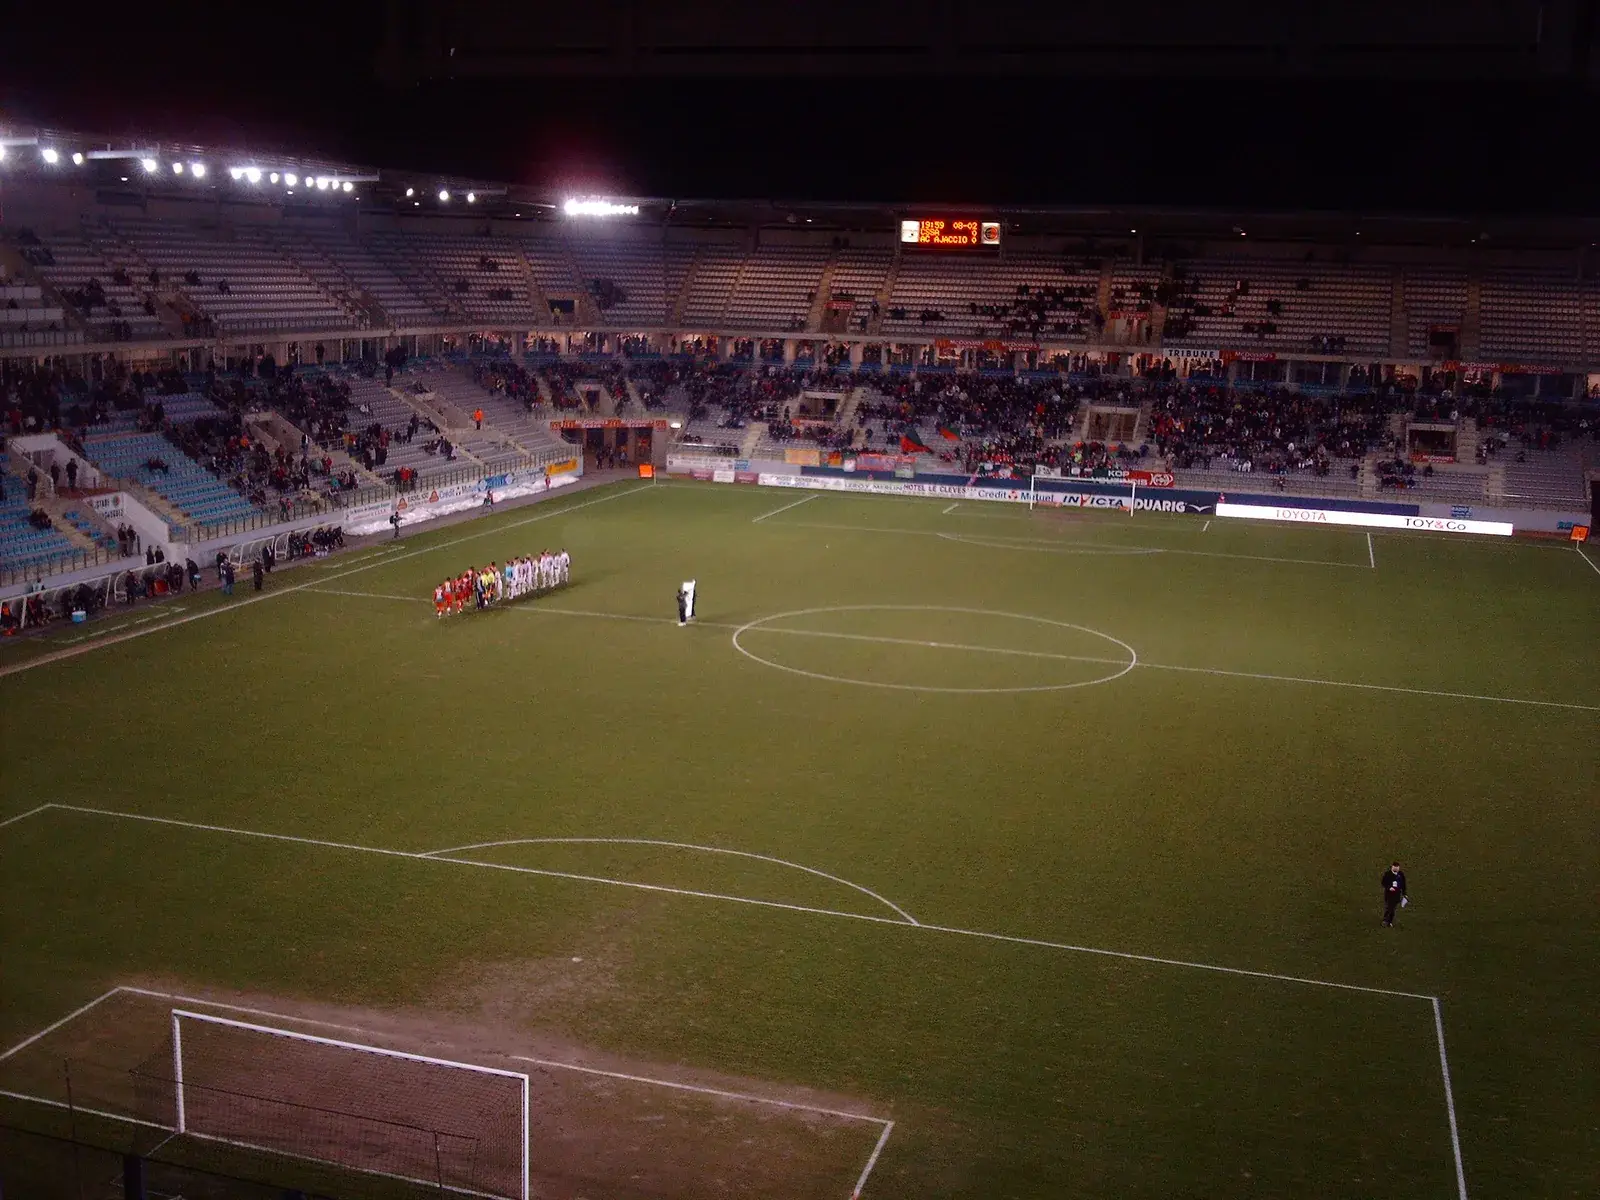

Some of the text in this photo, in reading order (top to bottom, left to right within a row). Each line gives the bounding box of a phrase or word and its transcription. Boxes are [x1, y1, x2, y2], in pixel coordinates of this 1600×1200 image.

[921, 221, 978, 230] 19:59 08-02
[934, 236, 968, 244] AJACCIO
[1168, 349, 1215, 358] TRIBUNE
[1020, 492, 1054, 503] Mutuel
[1063, 494, 1124, 507] INVICTA
[1134, 499, 1185, 512] DUARIG
[1275, 509, 1327, 521] TOYOTA
[1404, 518, 1466, 531] TOY&Co
